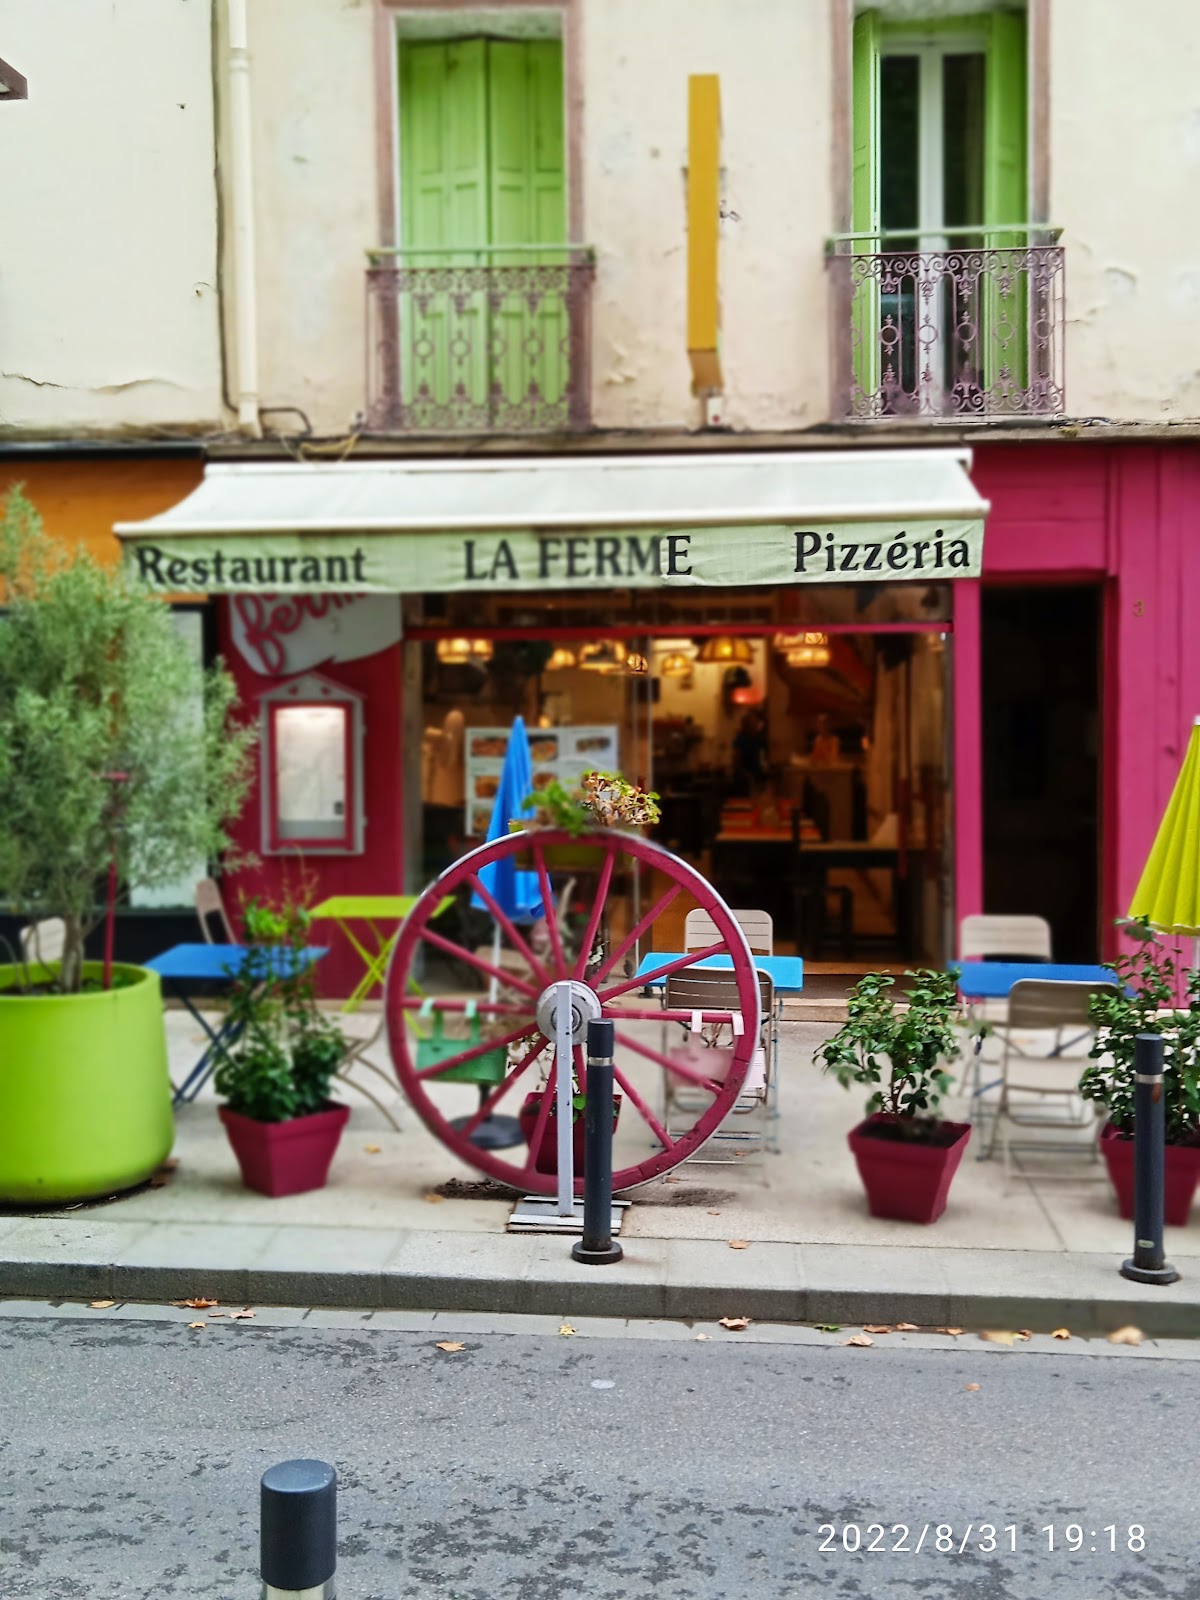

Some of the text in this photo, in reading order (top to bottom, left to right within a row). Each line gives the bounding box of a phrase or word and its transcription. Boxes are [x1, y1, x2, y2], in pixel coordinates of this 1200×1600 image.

[136, 529, 970, 585] Restaurant LA FERME Pizzéria
